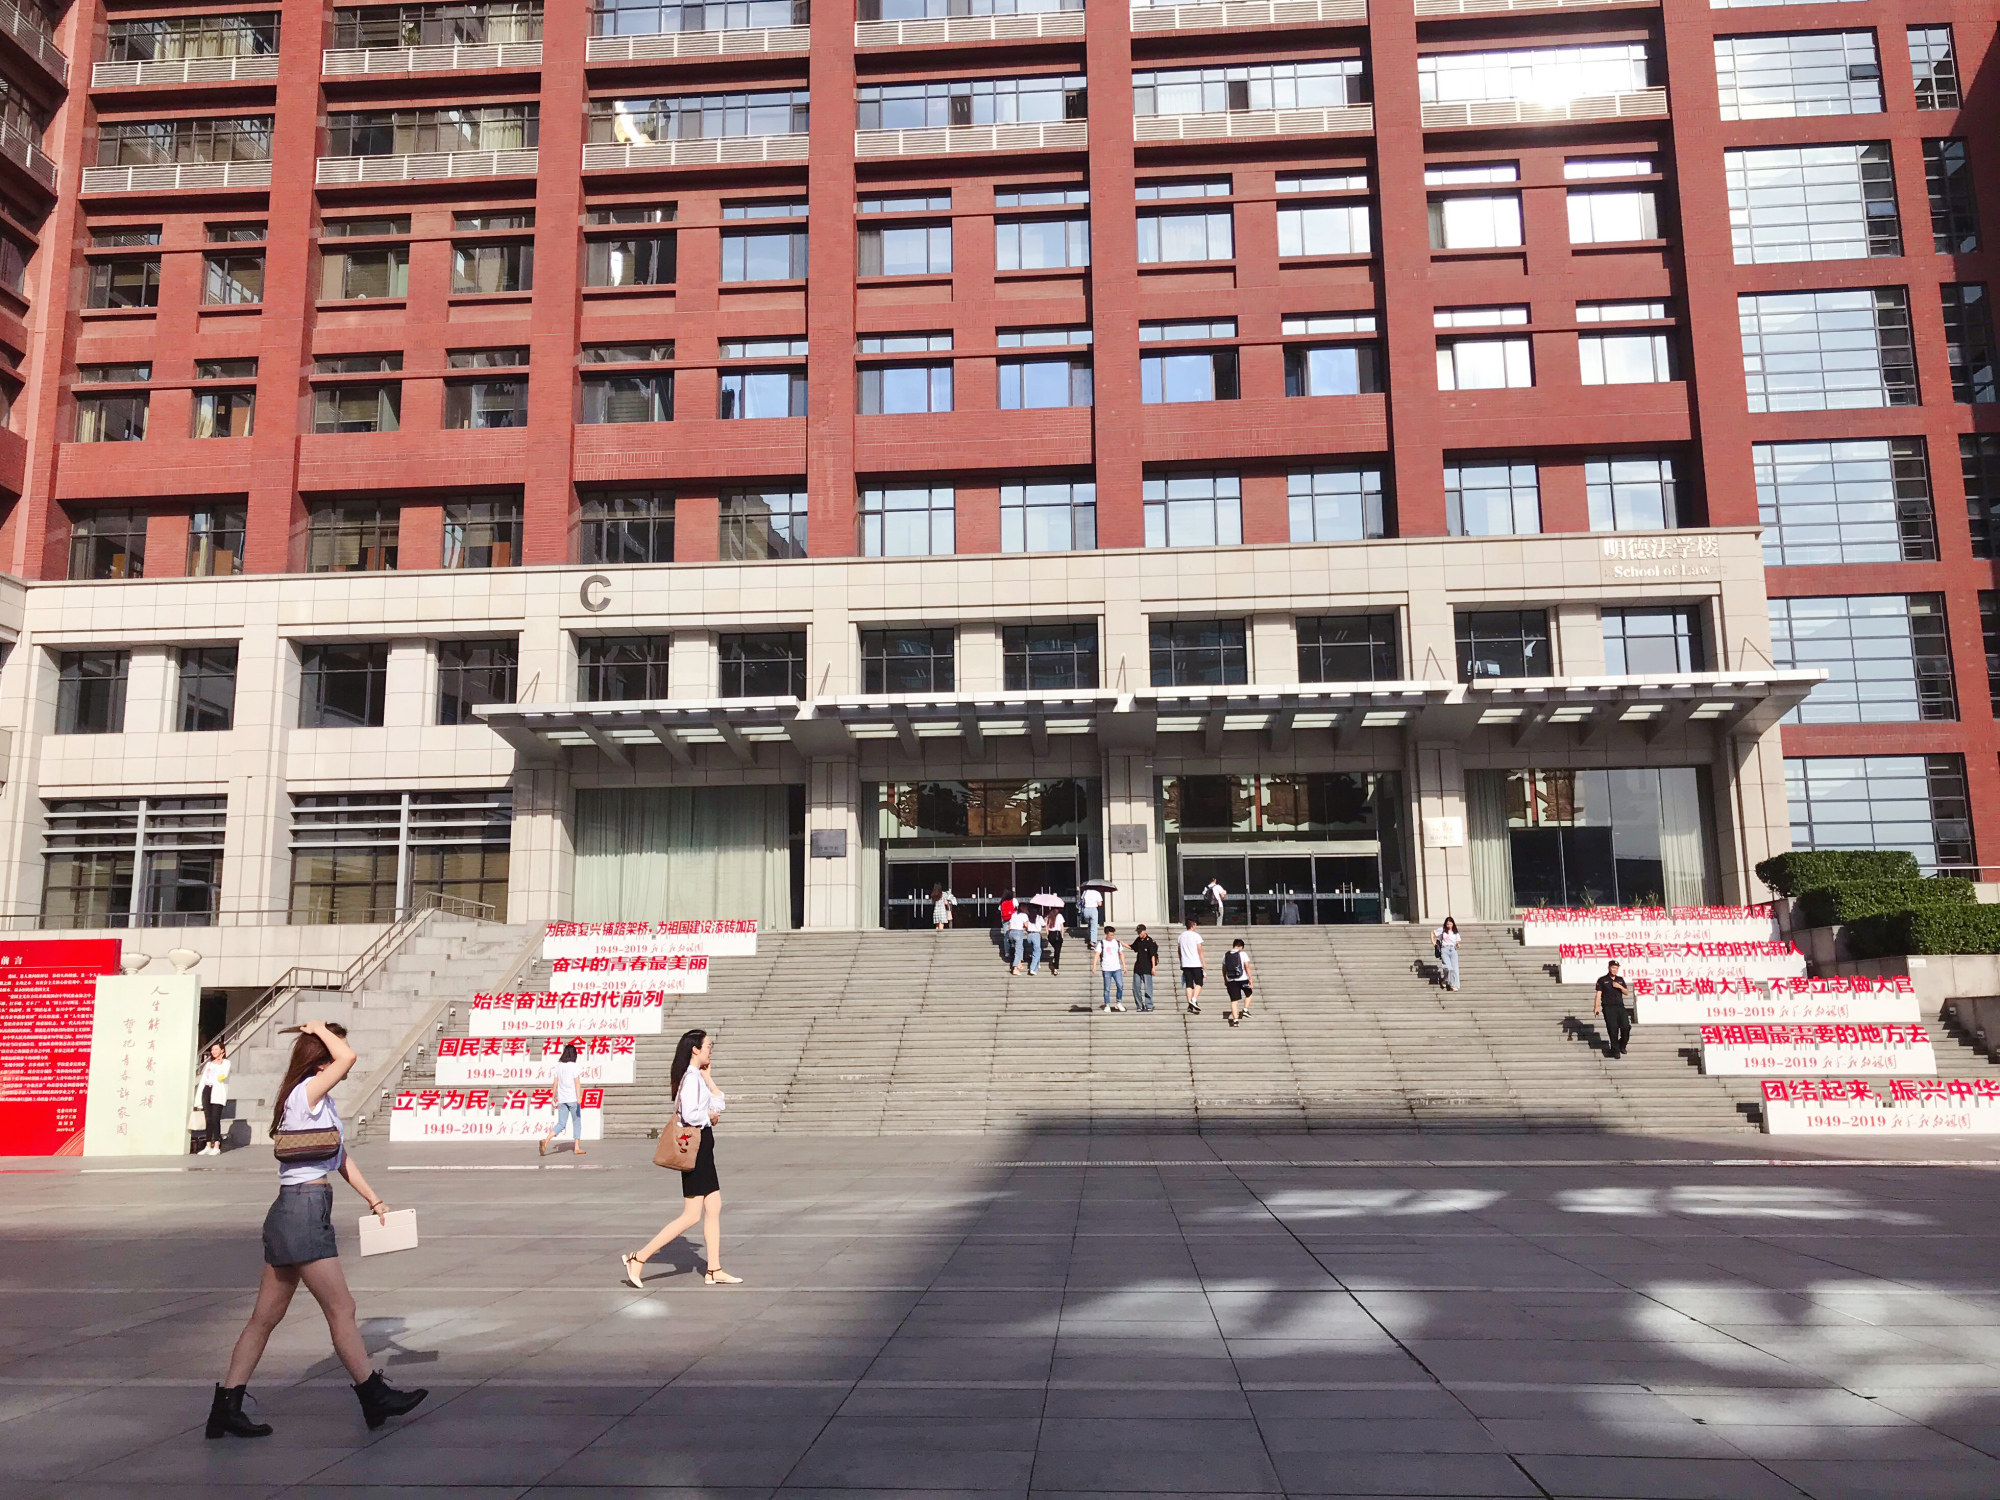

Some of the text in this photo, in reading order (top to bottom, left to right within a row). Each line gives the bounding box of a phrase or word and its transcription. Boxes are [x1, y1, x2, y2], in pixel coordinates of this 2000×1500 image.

[1603, 536, 1719, 559] 明德法学楼
[1614, 564, 1711, 578] School of Law
[580, 574, 612, 612] C
[545, 919, 757, 937] 为民族复兴铺路架桥，为祖国建设添砖加瓦
[1593, 931, 1650, 940] 1949-2019
[595, 944, 648, 954] 1949-2019
[1559, 940, 1804, 959] 做担当民族复兴大任的时代新人
[552, 955, 709, 972] 奋斗的青春最美丽
[1622, 968, 1682, 977] 1949-2019
[571, 980, 627, 990] 1949-2019
[1633, 975, 1915, 996] 要立志做大事，不要立志做大官
[472, 990, 665, 1010] 始终奋进在时代前列
[1706, 1006, 1775, 1018] 1949-2019
[501, 1019, 563, 1031] 1949-2019
[1700, 1024, 1931, 1045] 到祖国最需要的地方去
[437, 1036, 636, 1057] 国民表率，社会栋梁
[1743, 1056, 1818, 1068] 1949-2019
[467, 1068, 532, 1079] 1949-2019
[1760, 1078, 2000, 1101] 团结起来，振兴中华
[392, 1089, 604, 1111] 立学为民，治学国
[423, 1122, 493, 1135] 1949-2019
[1806, 1115, 1886, 1127] 1949-2019
